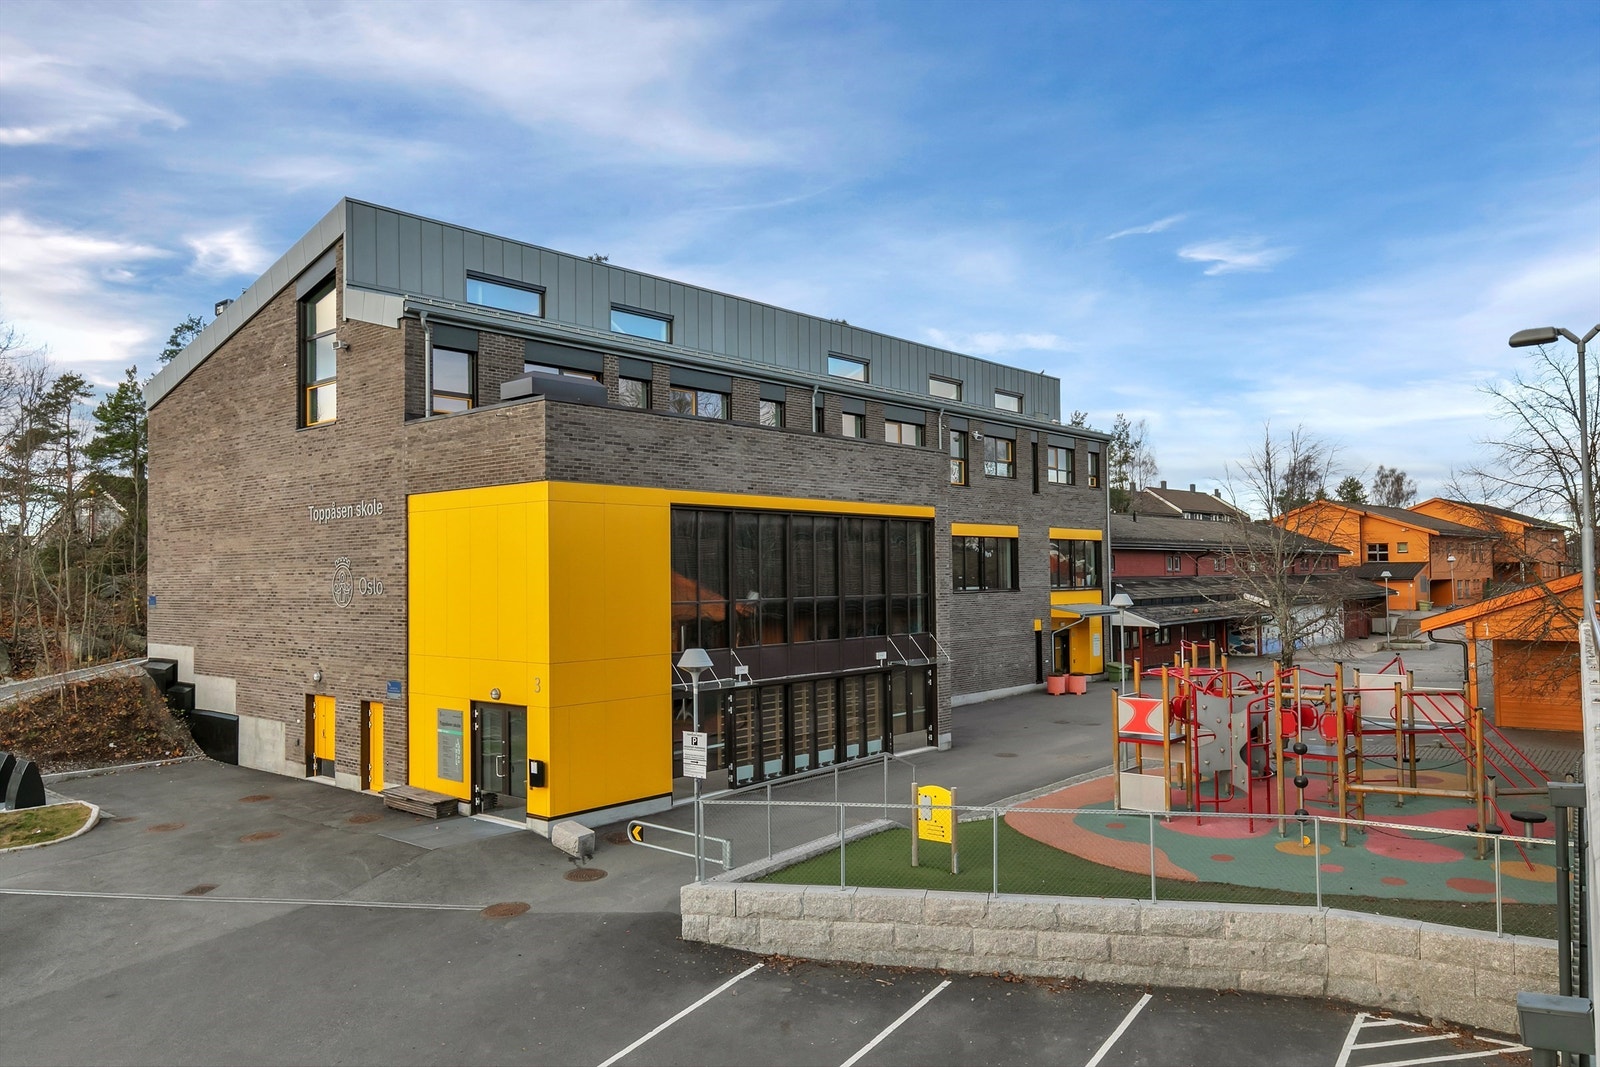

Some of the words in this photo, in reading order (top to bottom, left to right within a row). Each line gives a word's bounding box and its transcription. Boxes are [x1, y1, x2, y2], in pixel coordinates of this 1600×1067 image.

[308, 501, 353, 524] Toppåsen
[356, 499, 383, 517] skole
[359, 577, 384, 595] Oslo
[534, 677, 541, 693] 3
